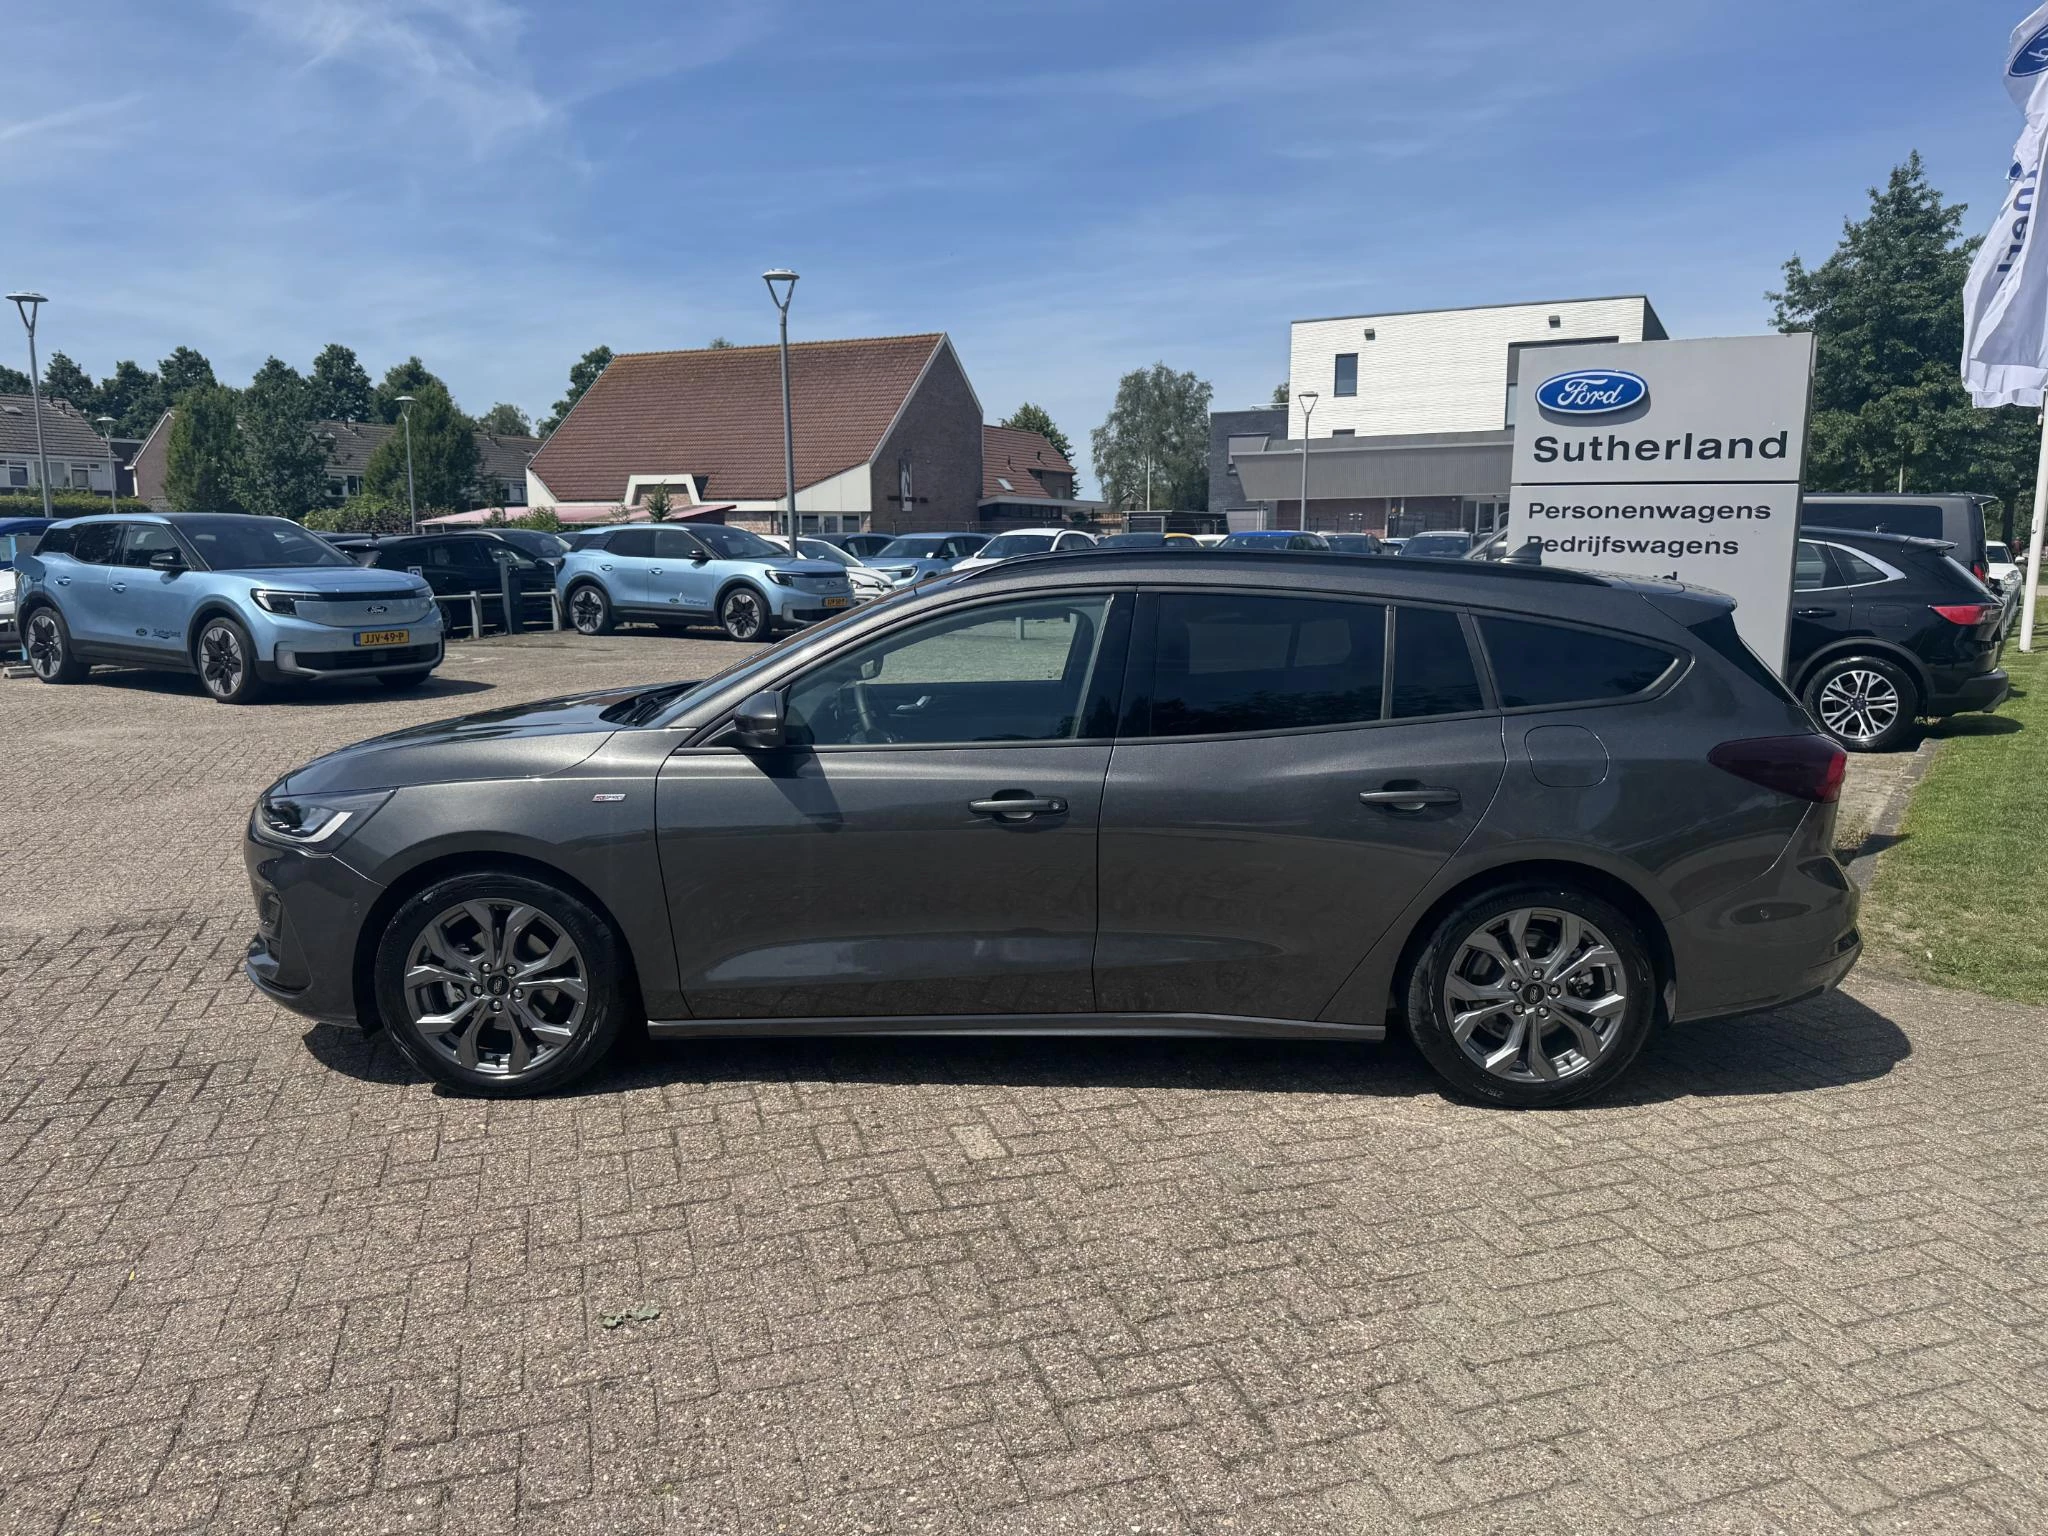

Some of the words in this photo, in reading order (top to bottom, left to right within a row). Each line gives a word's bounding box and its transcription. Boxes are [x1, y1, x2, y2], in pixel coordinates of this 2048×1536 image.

[1557, 378, 1624, 405] Ford
[1533, 430, 1788, 463] Sutherland
[1528, 502, 1771, 524] Personenwagens
[364, 632, 405, 644] JJV-49-P
